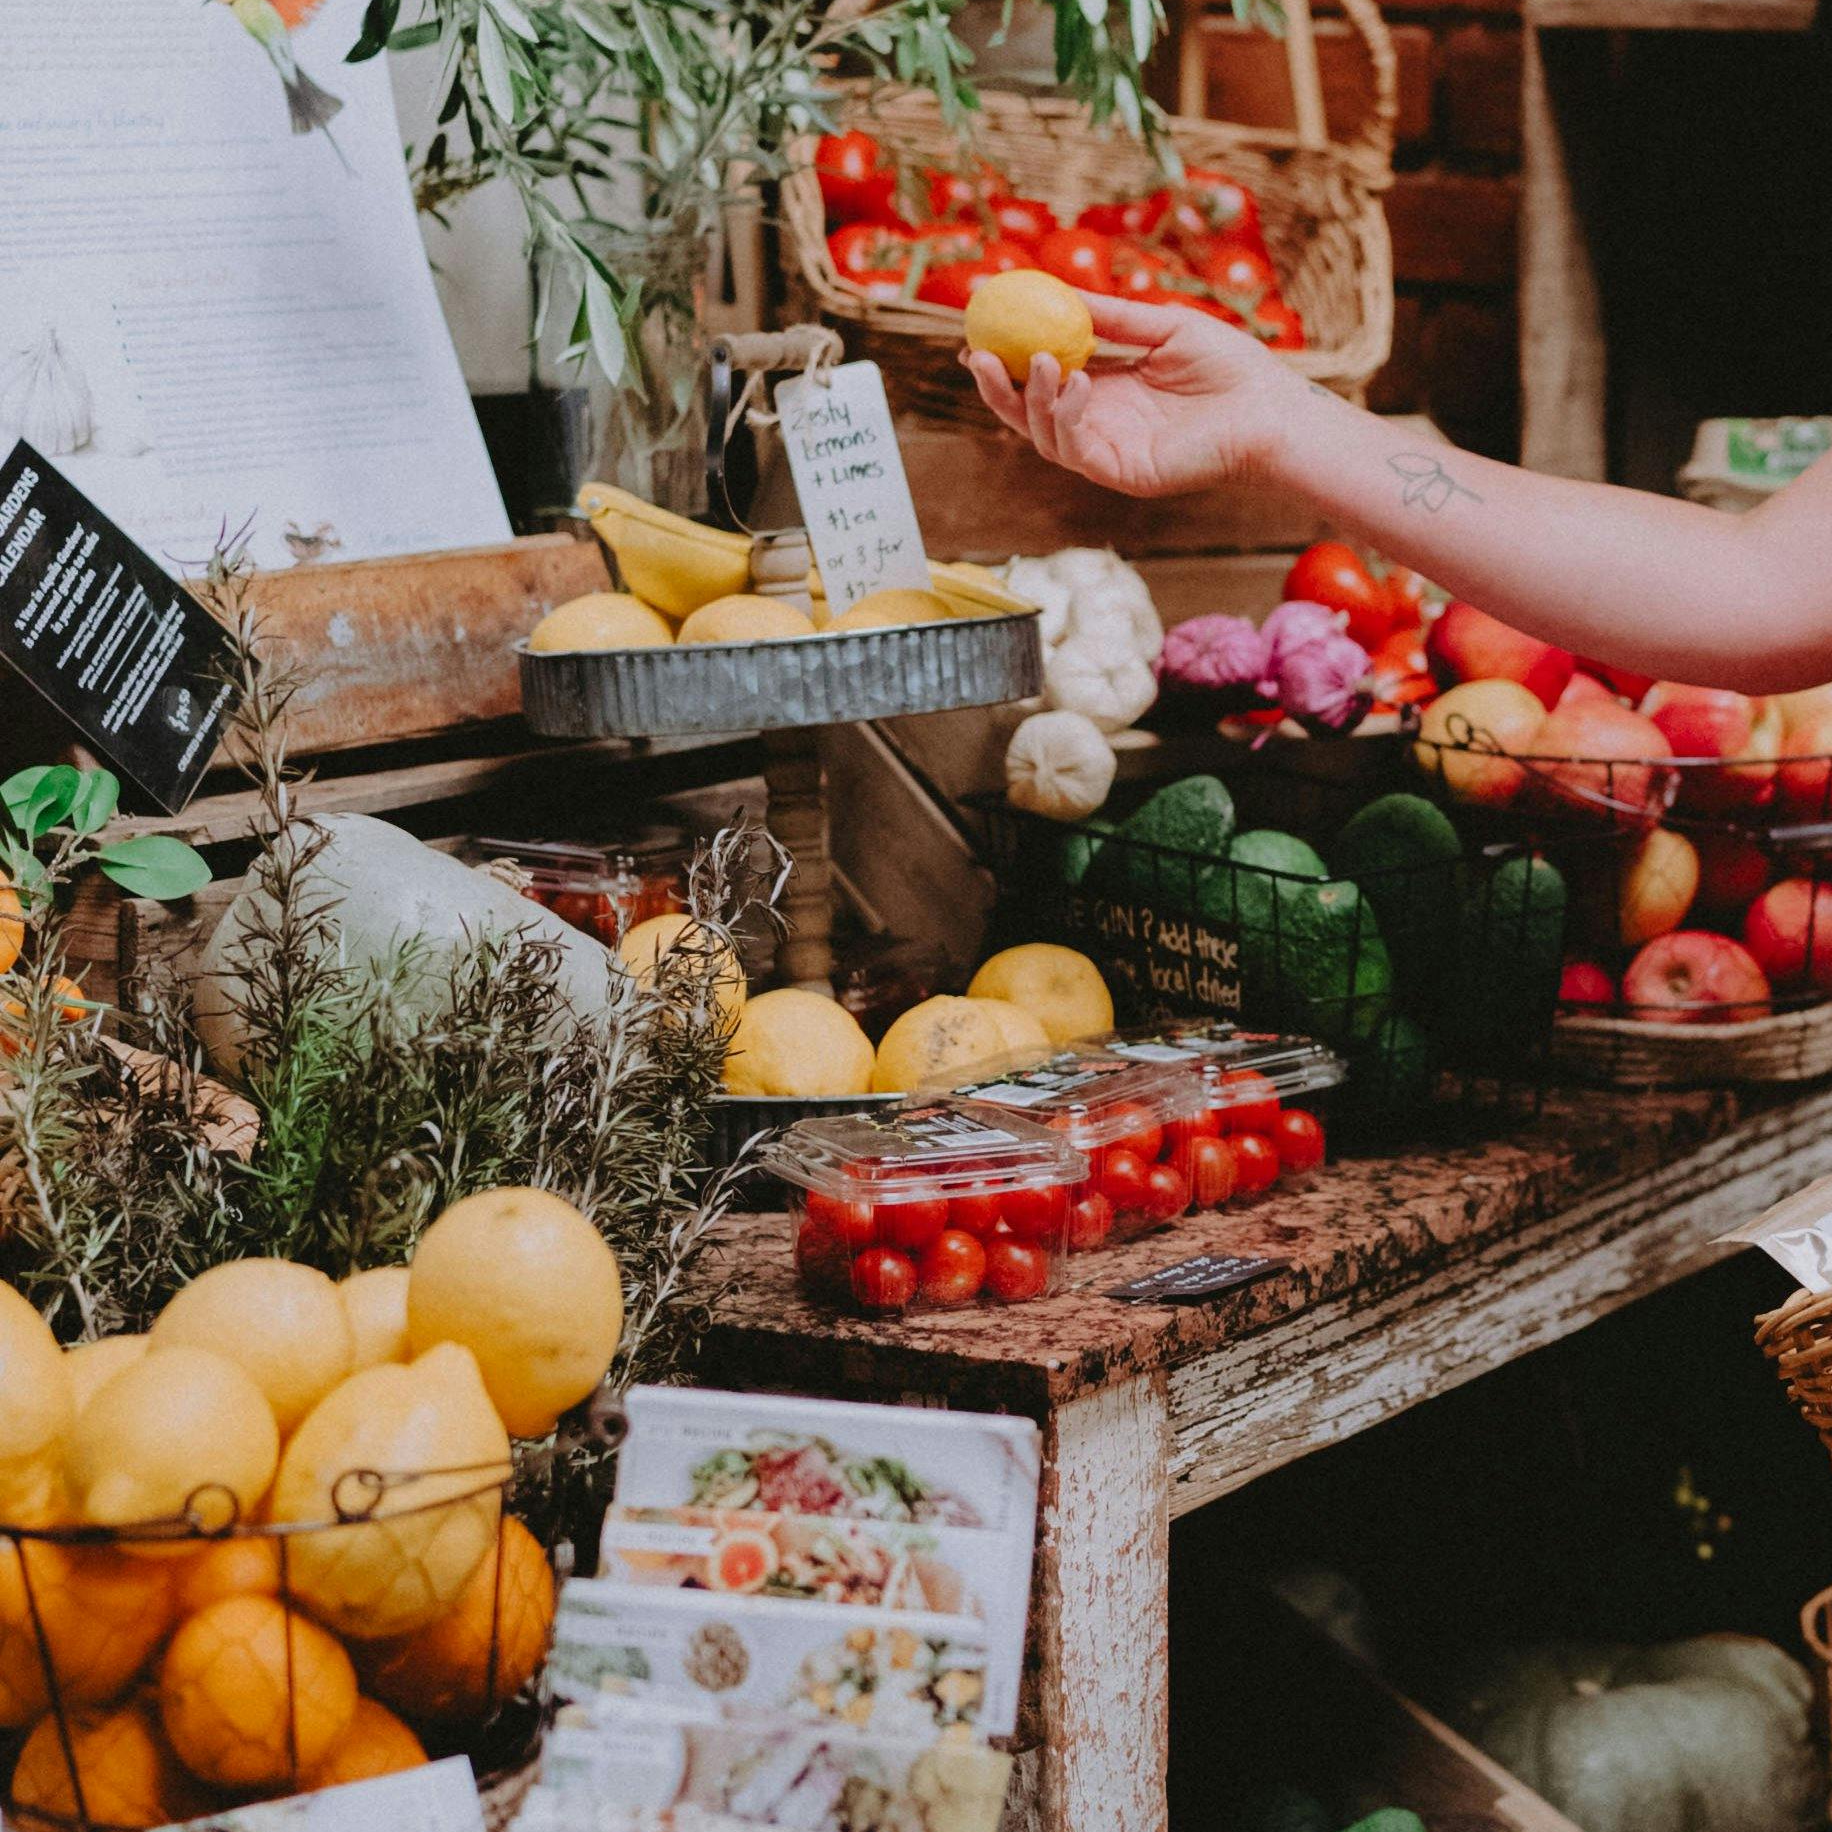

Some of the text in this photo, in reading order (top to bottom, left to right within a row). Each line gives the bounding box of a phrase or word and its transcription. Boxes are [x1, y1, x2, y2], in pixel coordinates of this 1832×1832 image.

[801, 426, 877, 462] Lemons
[0, 466, 40, 538] ARDENS
[0, 507, 47, 588] ALENDAR
